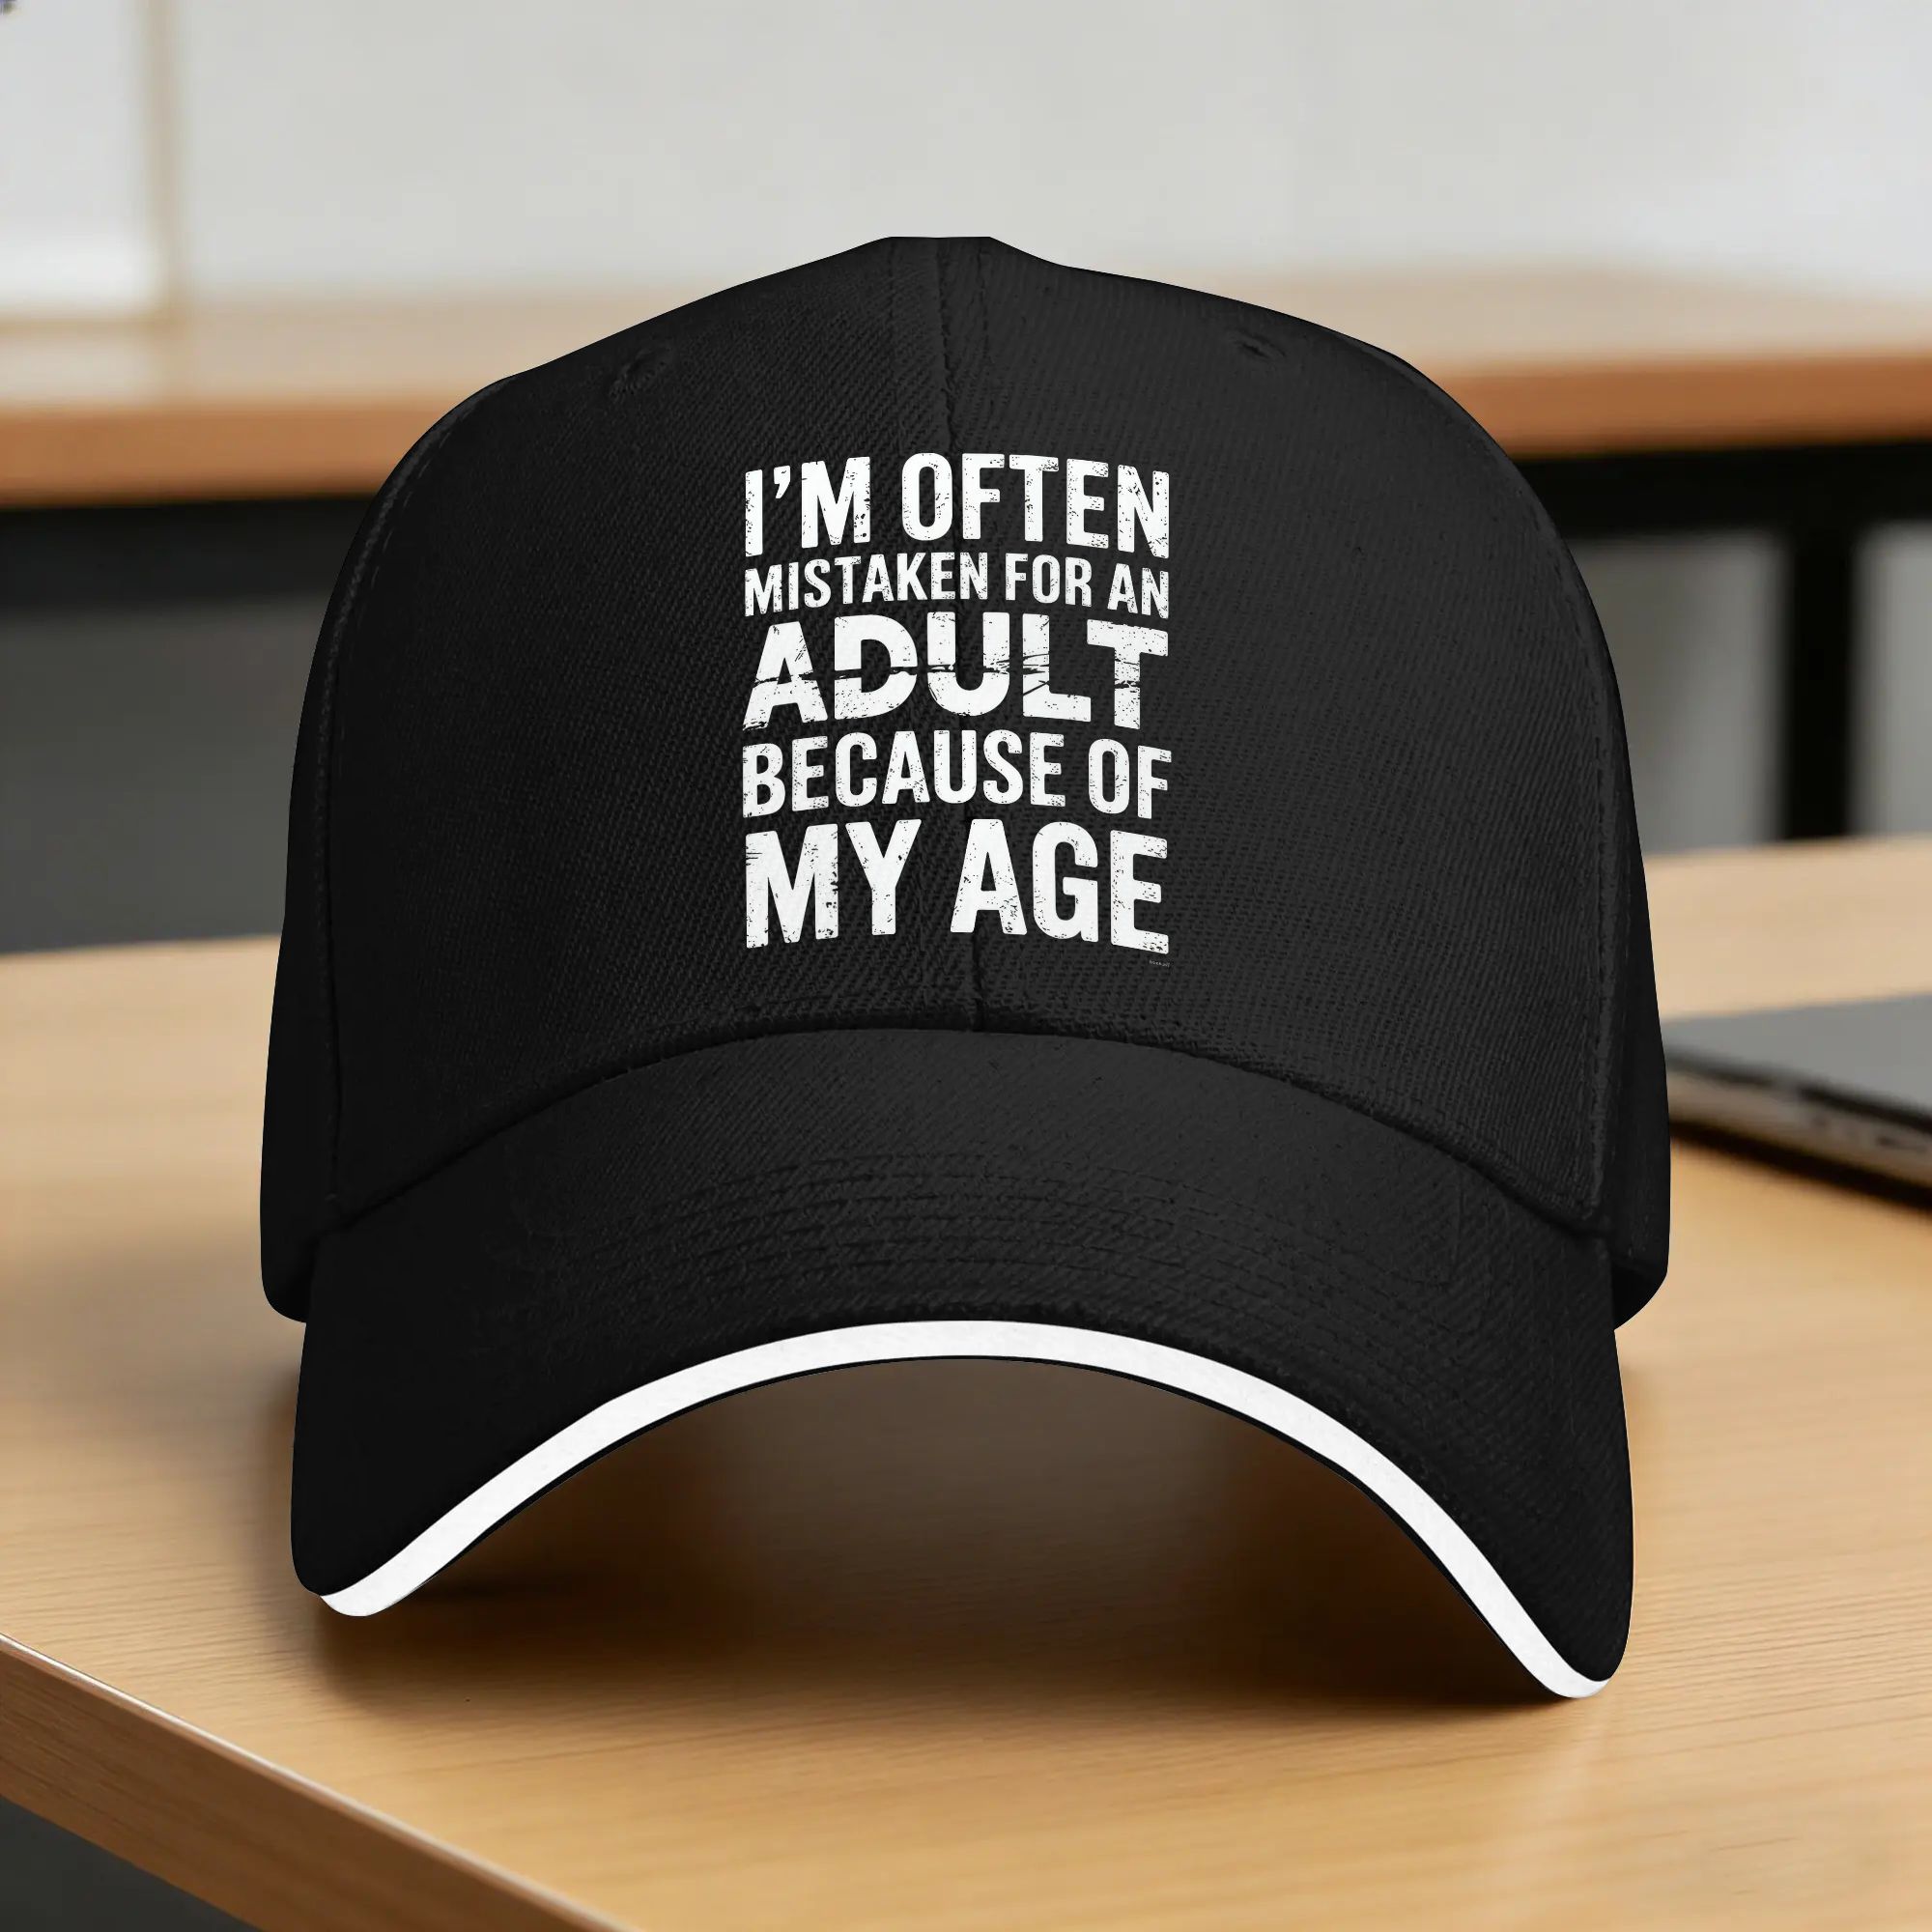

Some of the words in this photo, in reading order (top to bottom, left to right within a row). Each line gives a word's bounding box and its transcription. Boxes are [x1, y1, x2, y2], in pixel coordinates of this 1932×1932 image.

[745, 456, 871, 557] I'M
[901, 452, 1170, 559] OFTEN
[744, 552, 988, 617] MISTAKEN
[1005, 552, 1093, 608] FOR
[1106, 562, 1170, 619] AN
[742, 611, 1169, 731] ADULT
[742, 728, 1066, 818] BECAUSE
[1088, 738, 1173, 820] OF
[745, 818, 923, 949] MY
[950, 818, 1170, 955] AGE
